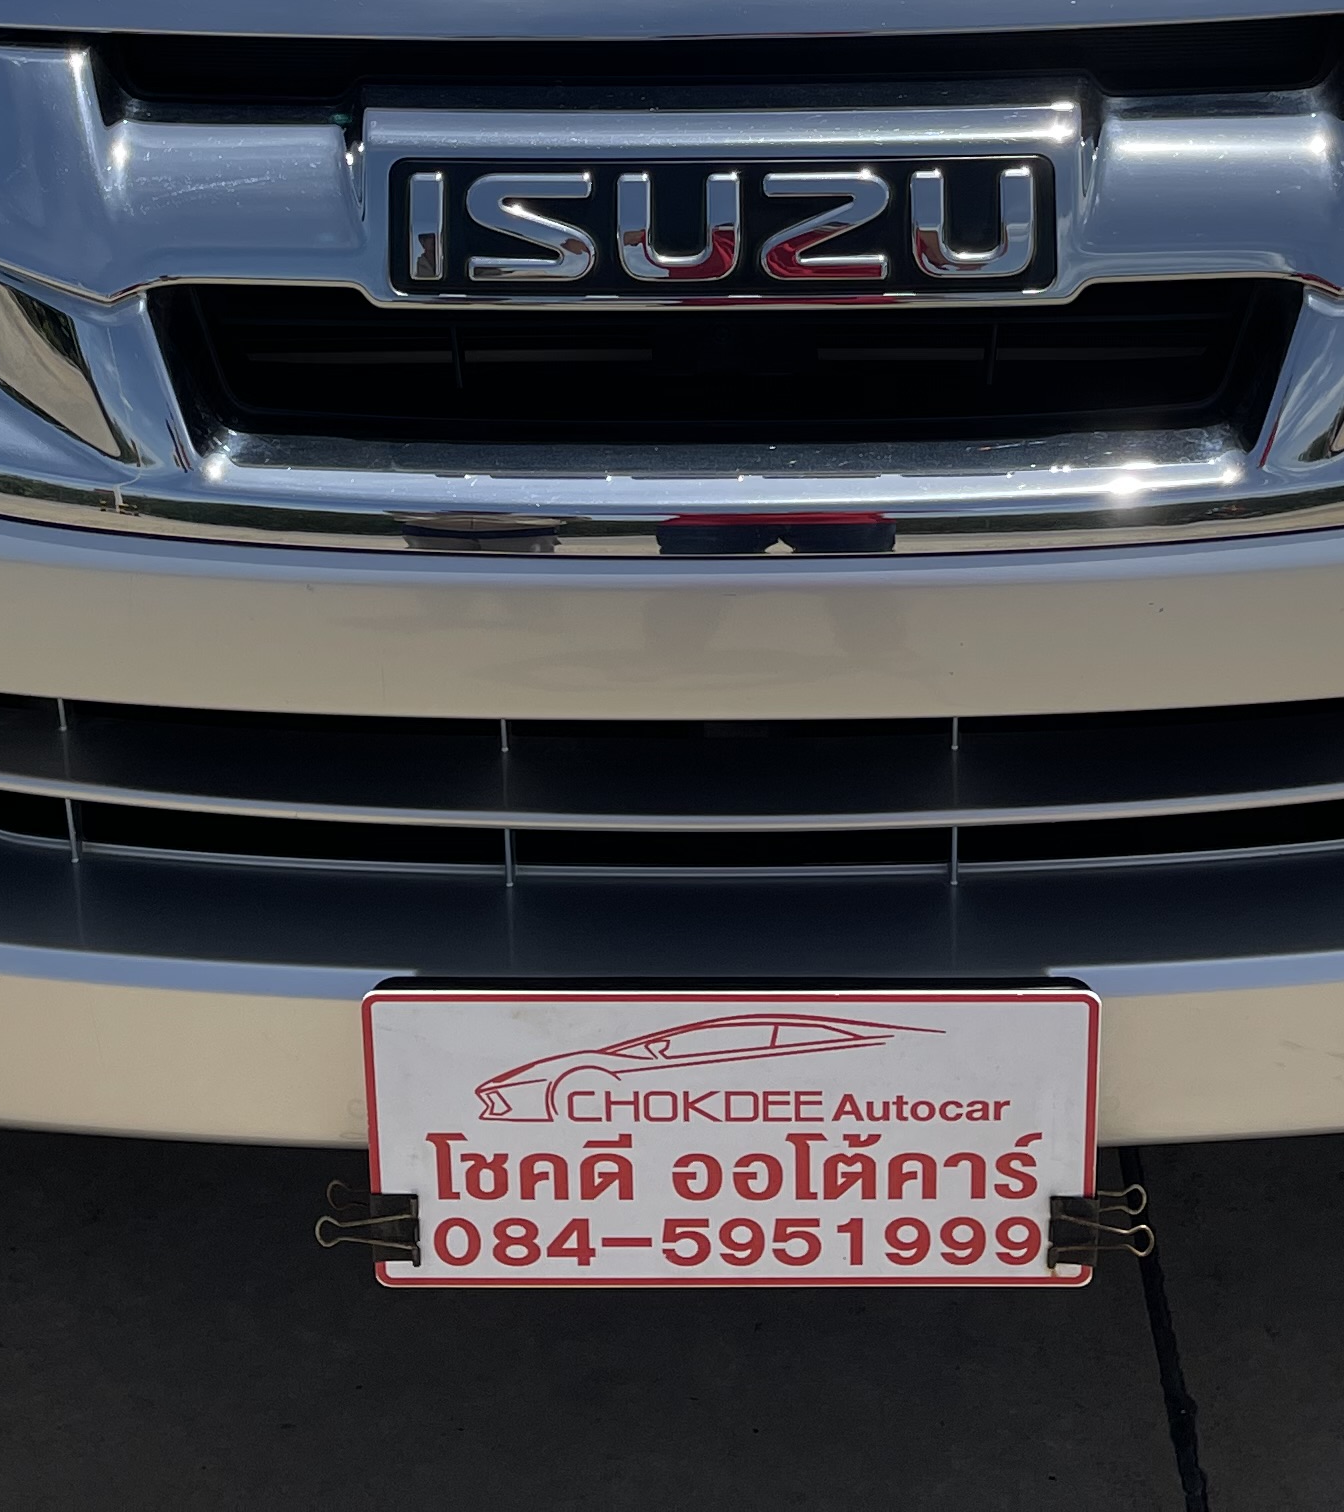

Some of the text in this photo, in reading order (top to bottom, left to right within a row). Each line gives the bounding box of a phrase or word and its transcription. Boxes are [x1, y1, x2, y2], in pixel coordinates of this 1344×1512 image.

[409, 168, 1034, 282] ISUZU
[567, 1090, 1010, 1123] CHOKDEE Autocar
[426, 1131, 1043, 1201] โชคดี ออโต้คาร์
[433, 1215, 1043, 1268] 084-5951999
